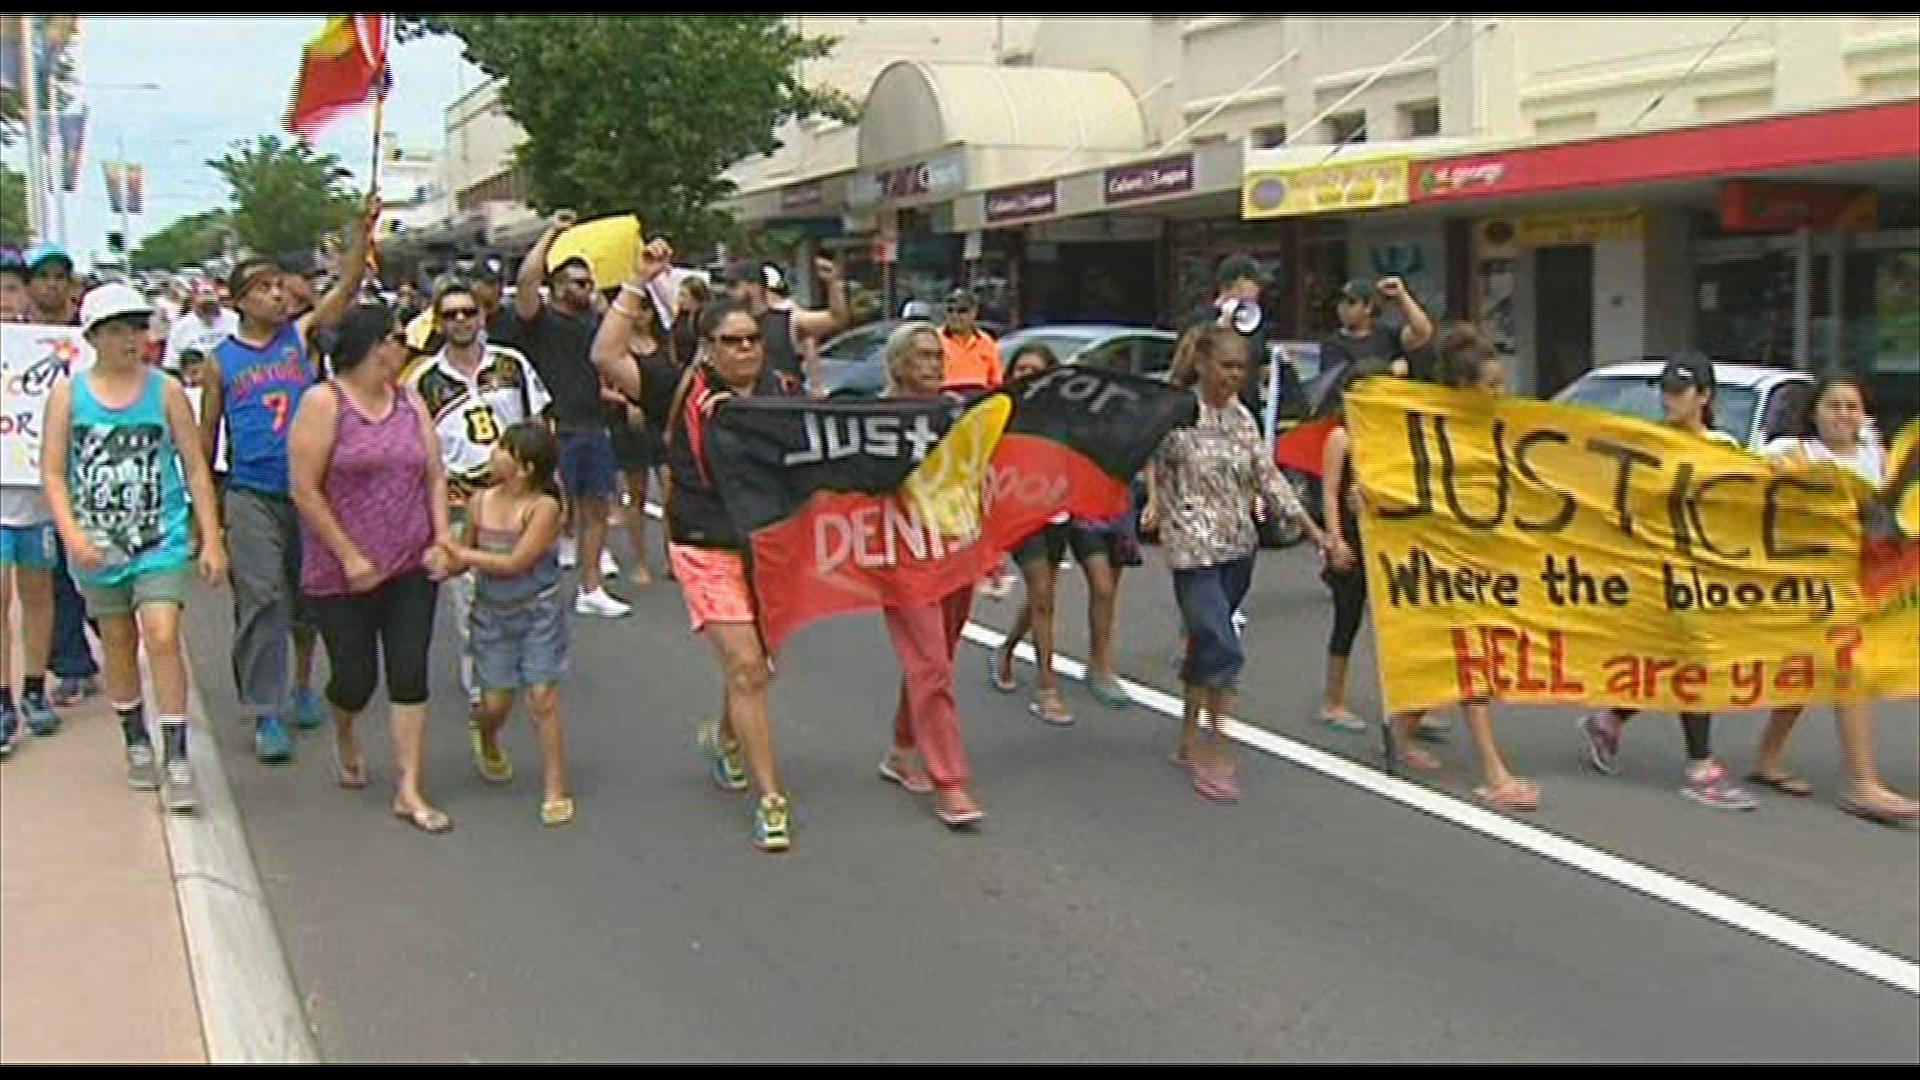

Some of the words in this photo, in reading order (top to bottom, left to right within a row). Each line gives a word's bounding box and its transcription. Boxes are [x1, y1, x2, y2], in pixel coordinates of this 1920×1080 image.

[262, 390, 289, 434] 7
[465, 405, 499, 444] B
[1376, 409, 1836, 560] JUSTICE
[1379, 547, 1520, 609] Where
[1541, 554, 1631, 609] the
[1452, 627, 1584, 699] HELL
[1600, 654, 1709, 704] are
